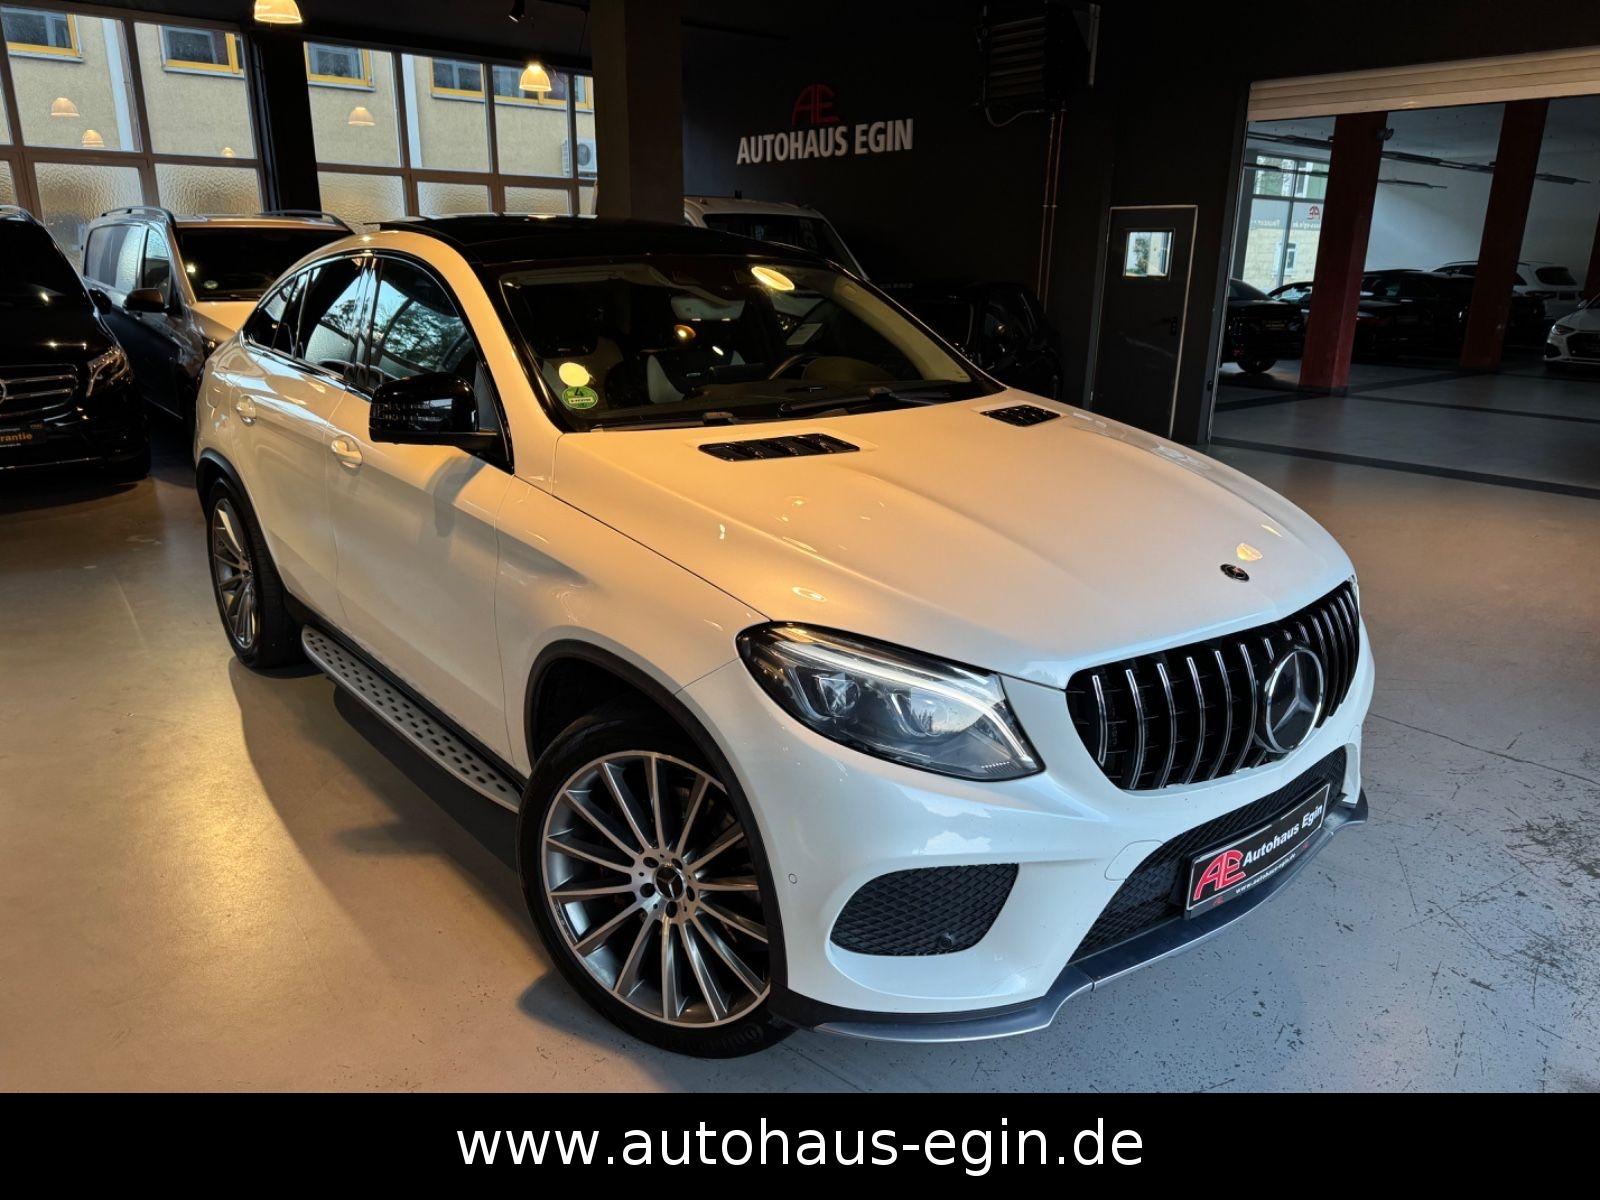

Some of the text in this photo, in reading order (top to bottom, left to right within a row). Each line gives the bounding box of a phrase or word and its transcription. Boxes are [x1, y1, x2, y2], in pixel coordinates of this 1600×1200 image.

[736, 118, 914, 165] AUTOHAUS EGIN
[1243, 824, 1299, 867] Autohaus
[1301, 804, 1323, 829] Egin
